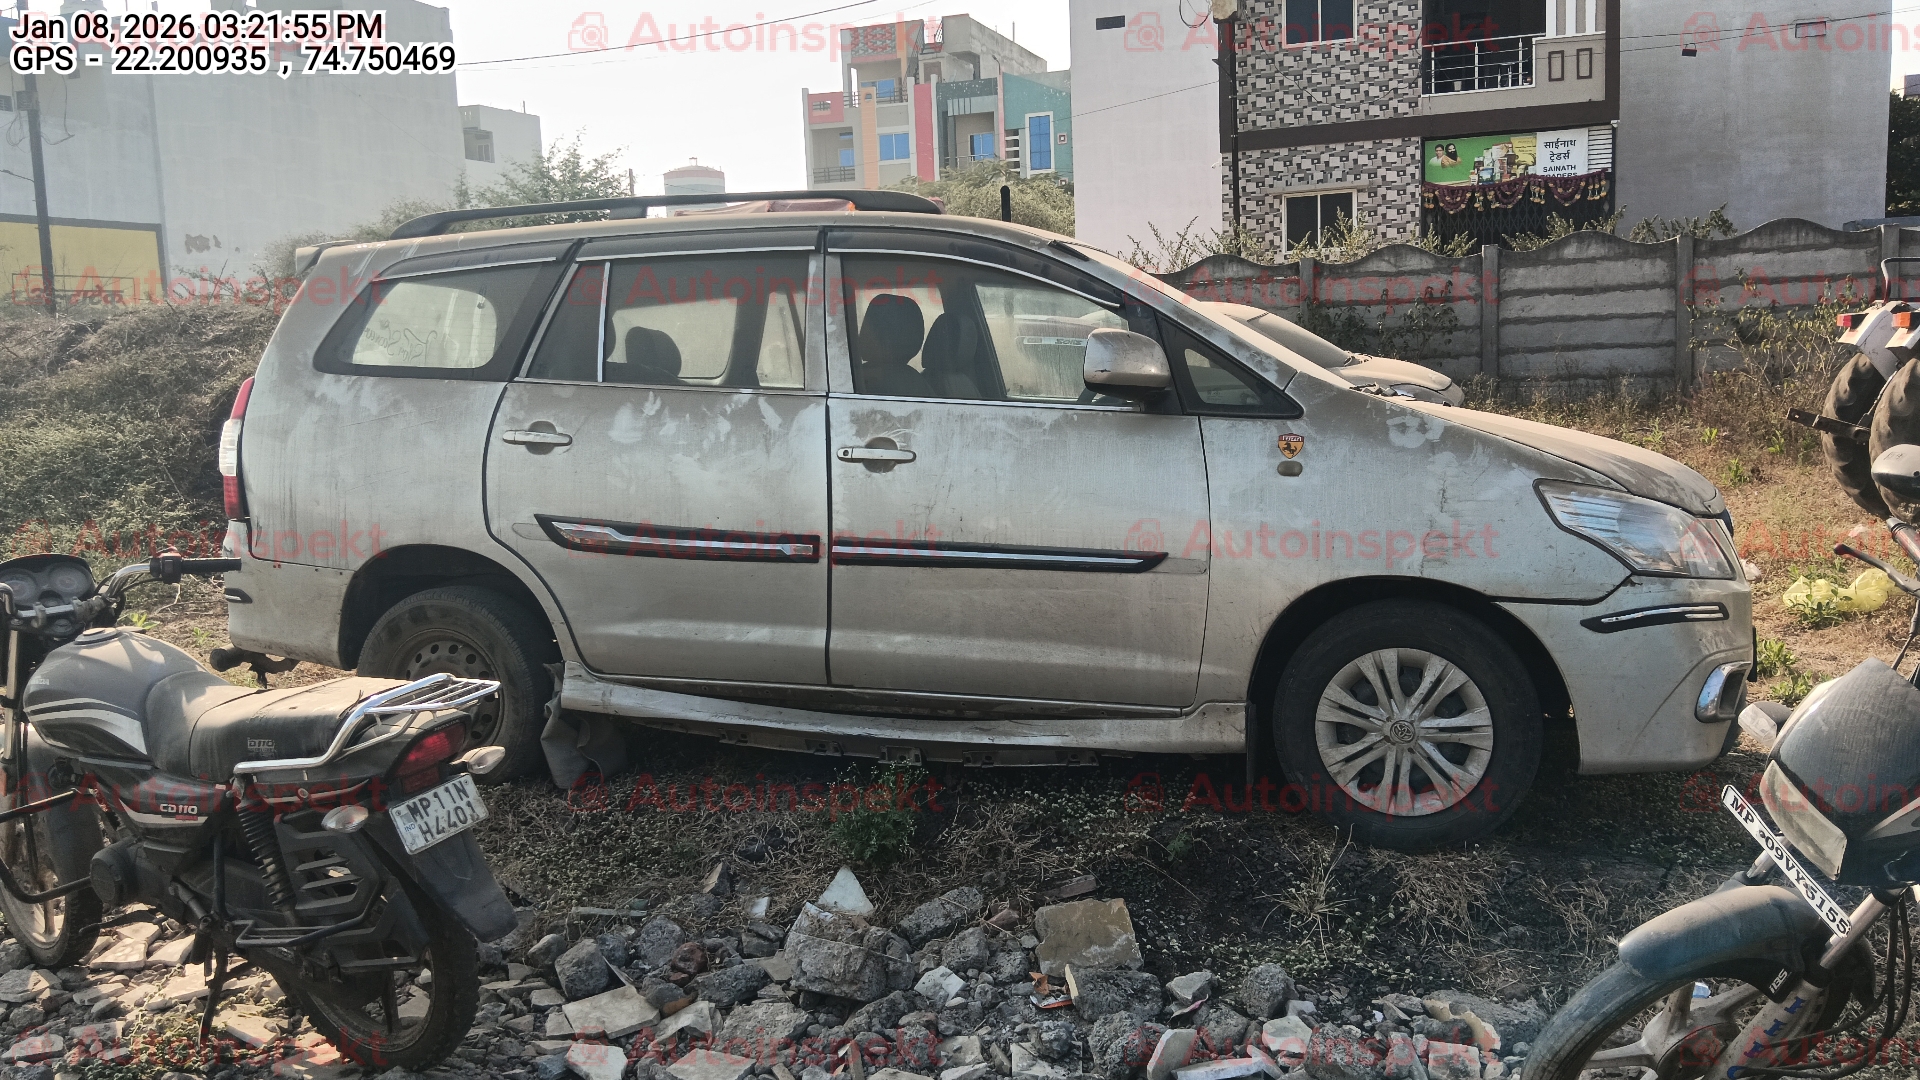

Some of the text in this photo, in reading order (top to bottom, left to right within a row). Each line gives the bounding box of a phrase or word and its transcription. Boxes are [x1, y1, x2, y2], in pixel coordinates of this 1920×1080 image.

[1543, 138, 1577, 149] साईनाथ
[1549, 150, 1571, 163] ट्रेडर्स
[1543, 165, 1576, 173] SAINATH
[1729, 795, 1755, 825] MP
[404, 821, 416, 832] IND
